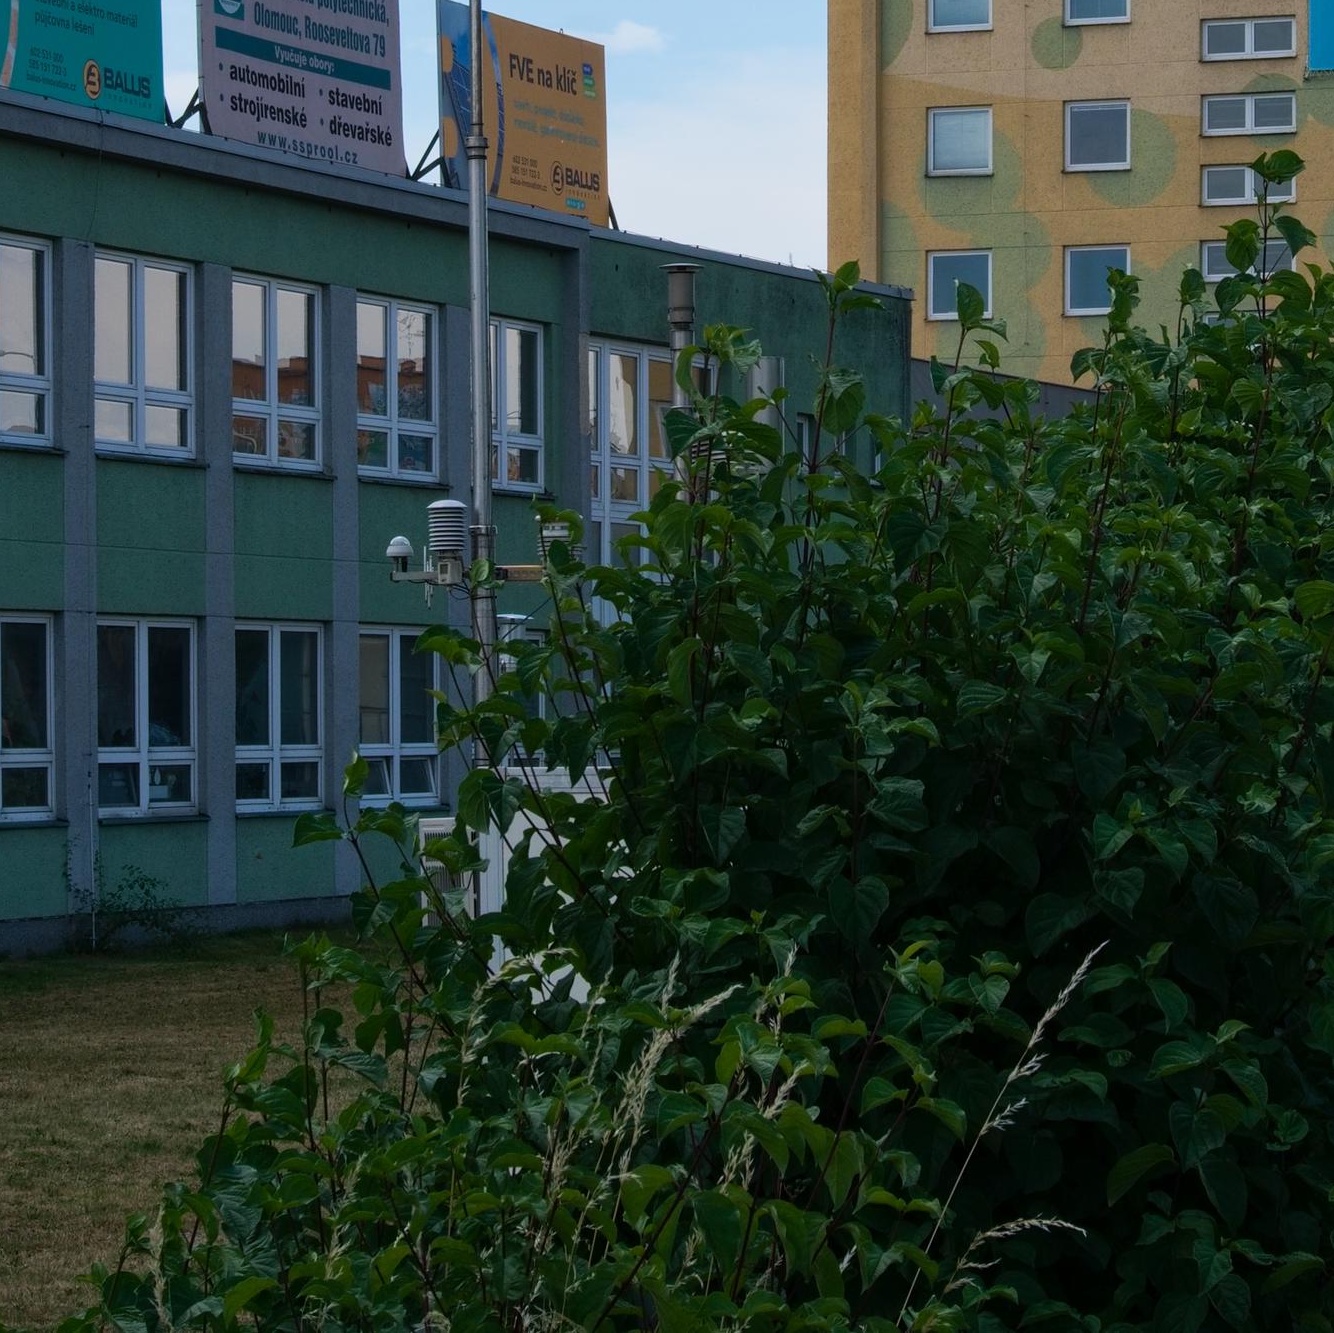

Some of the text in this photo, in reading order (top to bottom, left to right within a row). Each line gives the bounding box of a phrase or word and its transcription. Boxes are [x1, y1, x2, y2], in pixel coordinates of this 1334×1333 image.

[254, 1, 386, 58] Olomouc, Rooseveltova 79
[274, 45, 335, 75] Vyučuje obory:
[509, 53, 534, 84] FVE
[537, 67, 553, 89] na
[556, 63, 577, 97] klíč
[230, 63, 306, 99] automobilní
[230, 93, 307, 130] strojírenské
[328, 87, 383, 116] stavební
[257, 130, 359, 165] www.ssprool.cz
[329, 115, 392, 147] dřevařské
